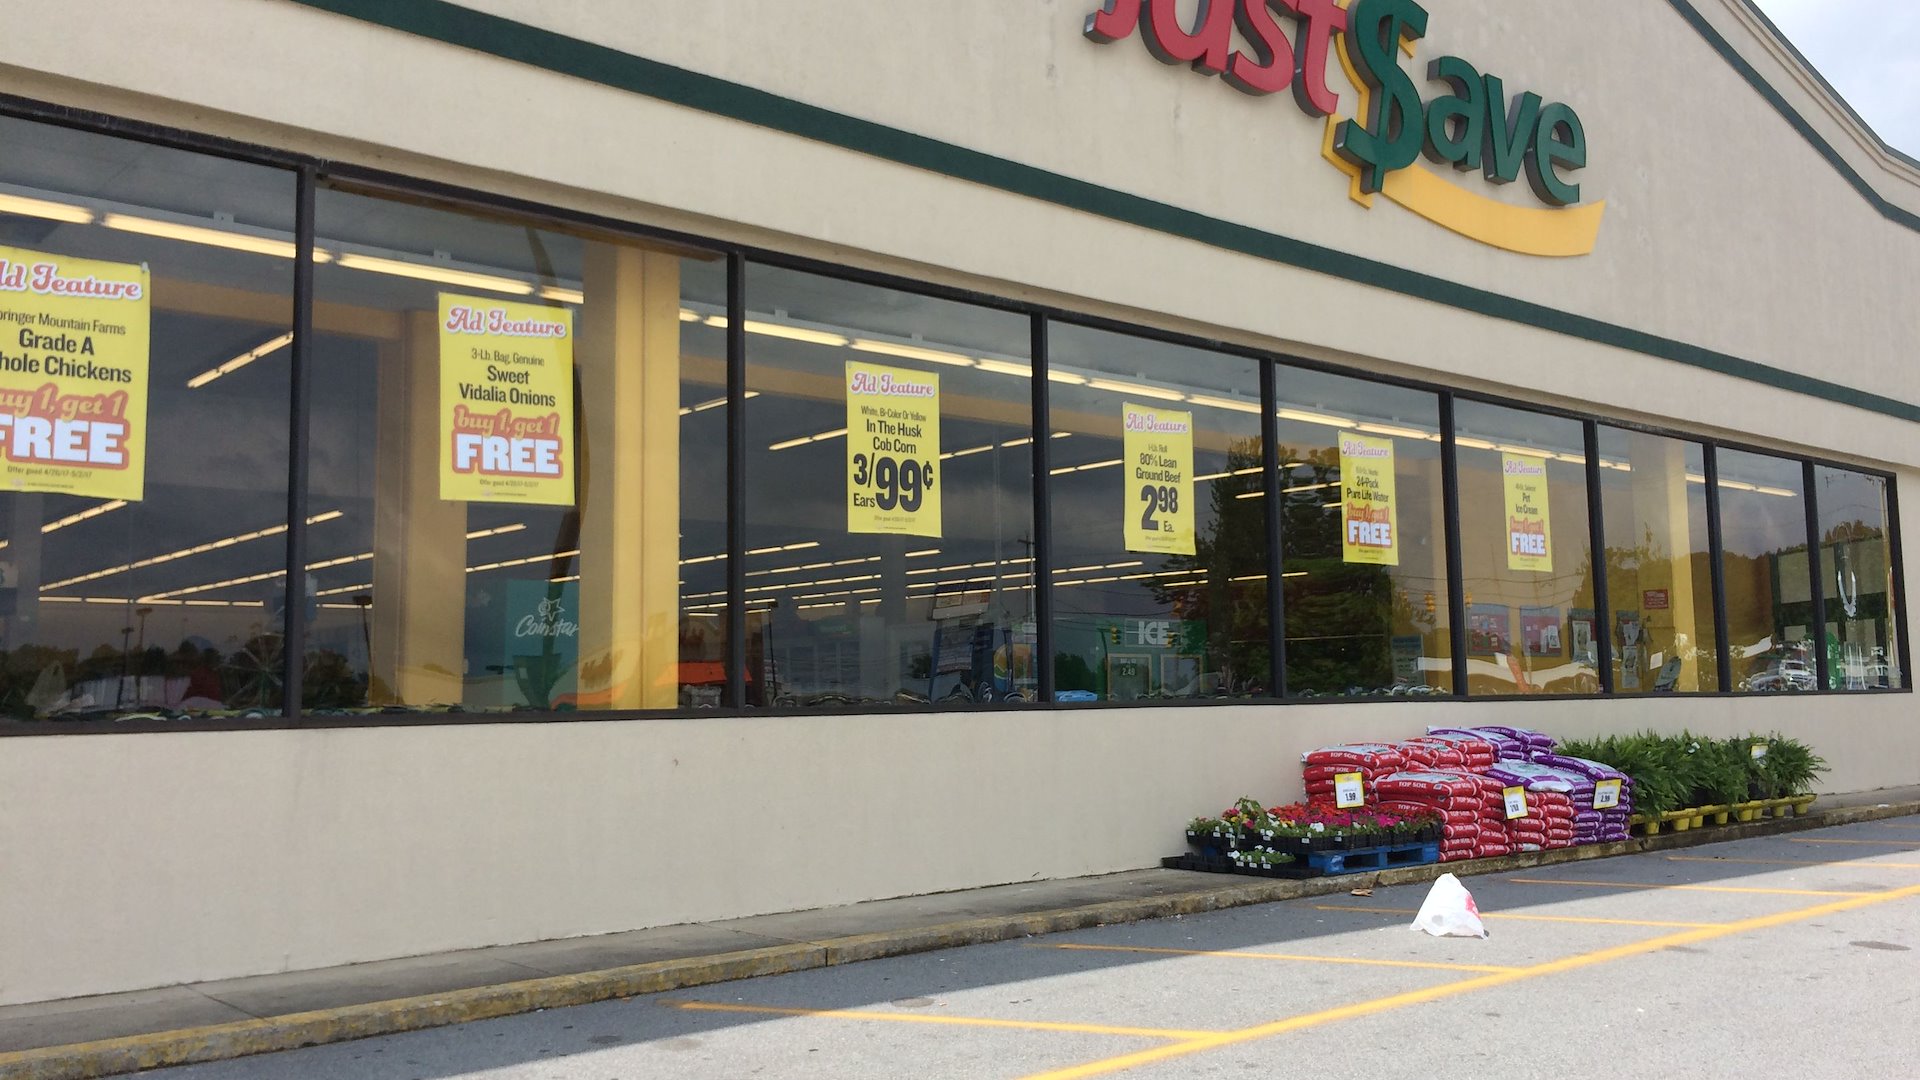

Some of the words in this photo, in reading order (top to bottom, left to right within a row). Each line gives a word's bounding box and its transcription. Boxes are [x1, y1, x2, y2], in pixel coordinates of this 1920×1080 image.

[0, 261, 24, 288] d
[32, 264, 140, 297] Feature
[0, 309, 35, 325] pringer
[39, 313, 90, 331] Mountain
[93, 320, 126, 335] Farms
[446, 307, 482, 332] Ad
[488, 309, 565, 336] Feature
[19, 328, 77, 353] Grade
[80, 336, 95, 356] A
[0, 352, 40, 373] hole
[44, 356, 132, 383] Chickens
[513, 353, 545, 367] Genuine
[487, 365, 530, 385] Sweet
[851, 372, 877, 393] Ad
[881, 374, 934, 396] Feature
[459, 382, 507, 404] Vidalia
[509, 387, 556, 407] Onions
[0, 393, 33, 418] uy
[62, 396, 104, 422] get
[112, 396, 124, 417] 1
[910, 410, 927, 422] Yellow
[457, 409, 496, 436] buy
[514, 418, 544, 439] get
[550, 417, 558, 434] 1
[866, 418, 876, 434] In
[878, 420, 896, 436] The
[897, 422, 922, 438] Husk
[1126, 413, 1144, 430] Ad
[1147, 414, 1188, 432] Feature
[456, 433, 559, 475] FREE
[873, 437, 892, 452] Cob
[893, 438, 917, 454] Corn
[7, 465, 24, 474] Offer
[1140, 452, 1158, 467] 80%
[1159, 455, 1177, 469] Lean
[1136, 466, 1164, 482] Ground
[1164, 470, 1181, 484] Beef
[853, 493, 876, 508] Ears
[1347, 519, 1392, 546] FREE
[1510, 531, 1546, 555] FREE
[515, 614, 579, 637] Coinstar
[1138, 620, 1170, 645] ICE
[1343, 752, 1358, 760] SOIL
[1412, 781, 1427, 789] SOIL
